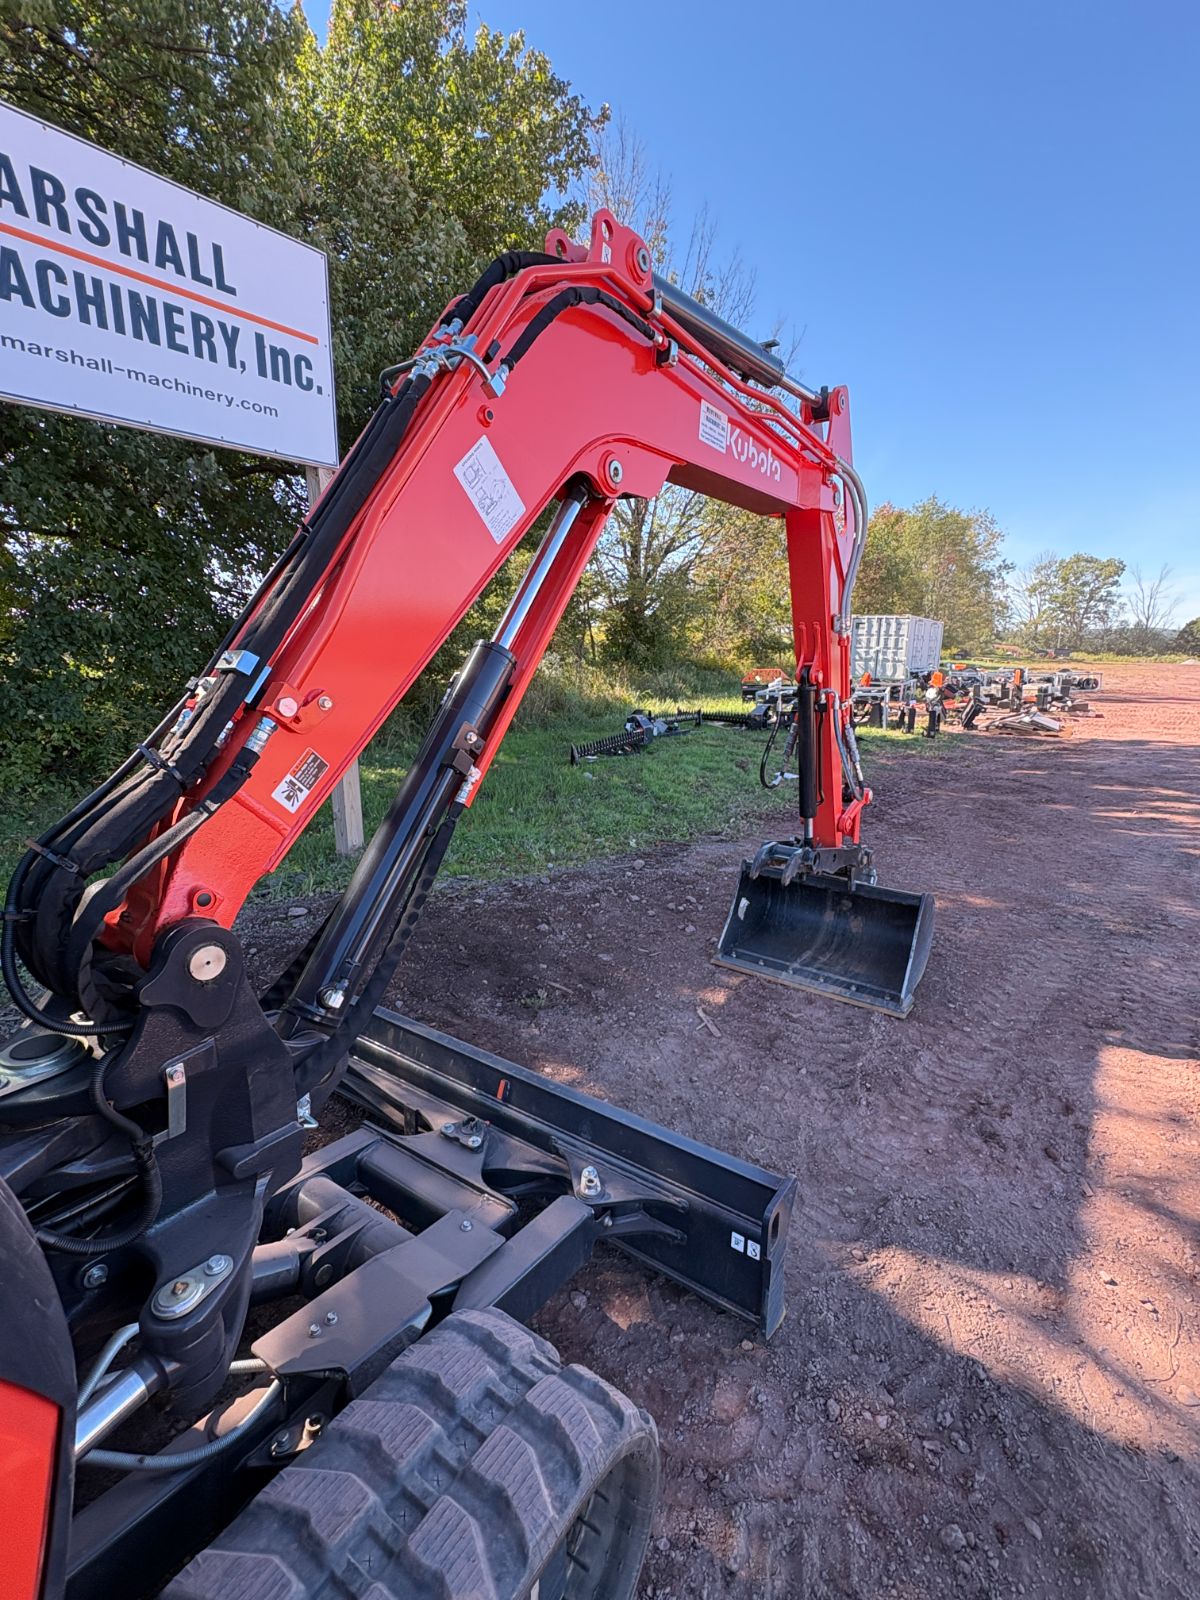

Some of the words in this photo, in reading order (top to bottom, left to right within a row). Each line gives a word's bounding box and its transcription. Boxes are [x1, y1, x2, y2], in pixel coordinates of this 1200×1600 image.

[0, 152, 237, 296] ARSHALL
[0, 245, 247, 374] ACHINERY,
[255, 331, 323, 395] Inc.
[0, 334, 279, 418] marshall-machinery.com
[726, 422, 781, 482] Kubota
